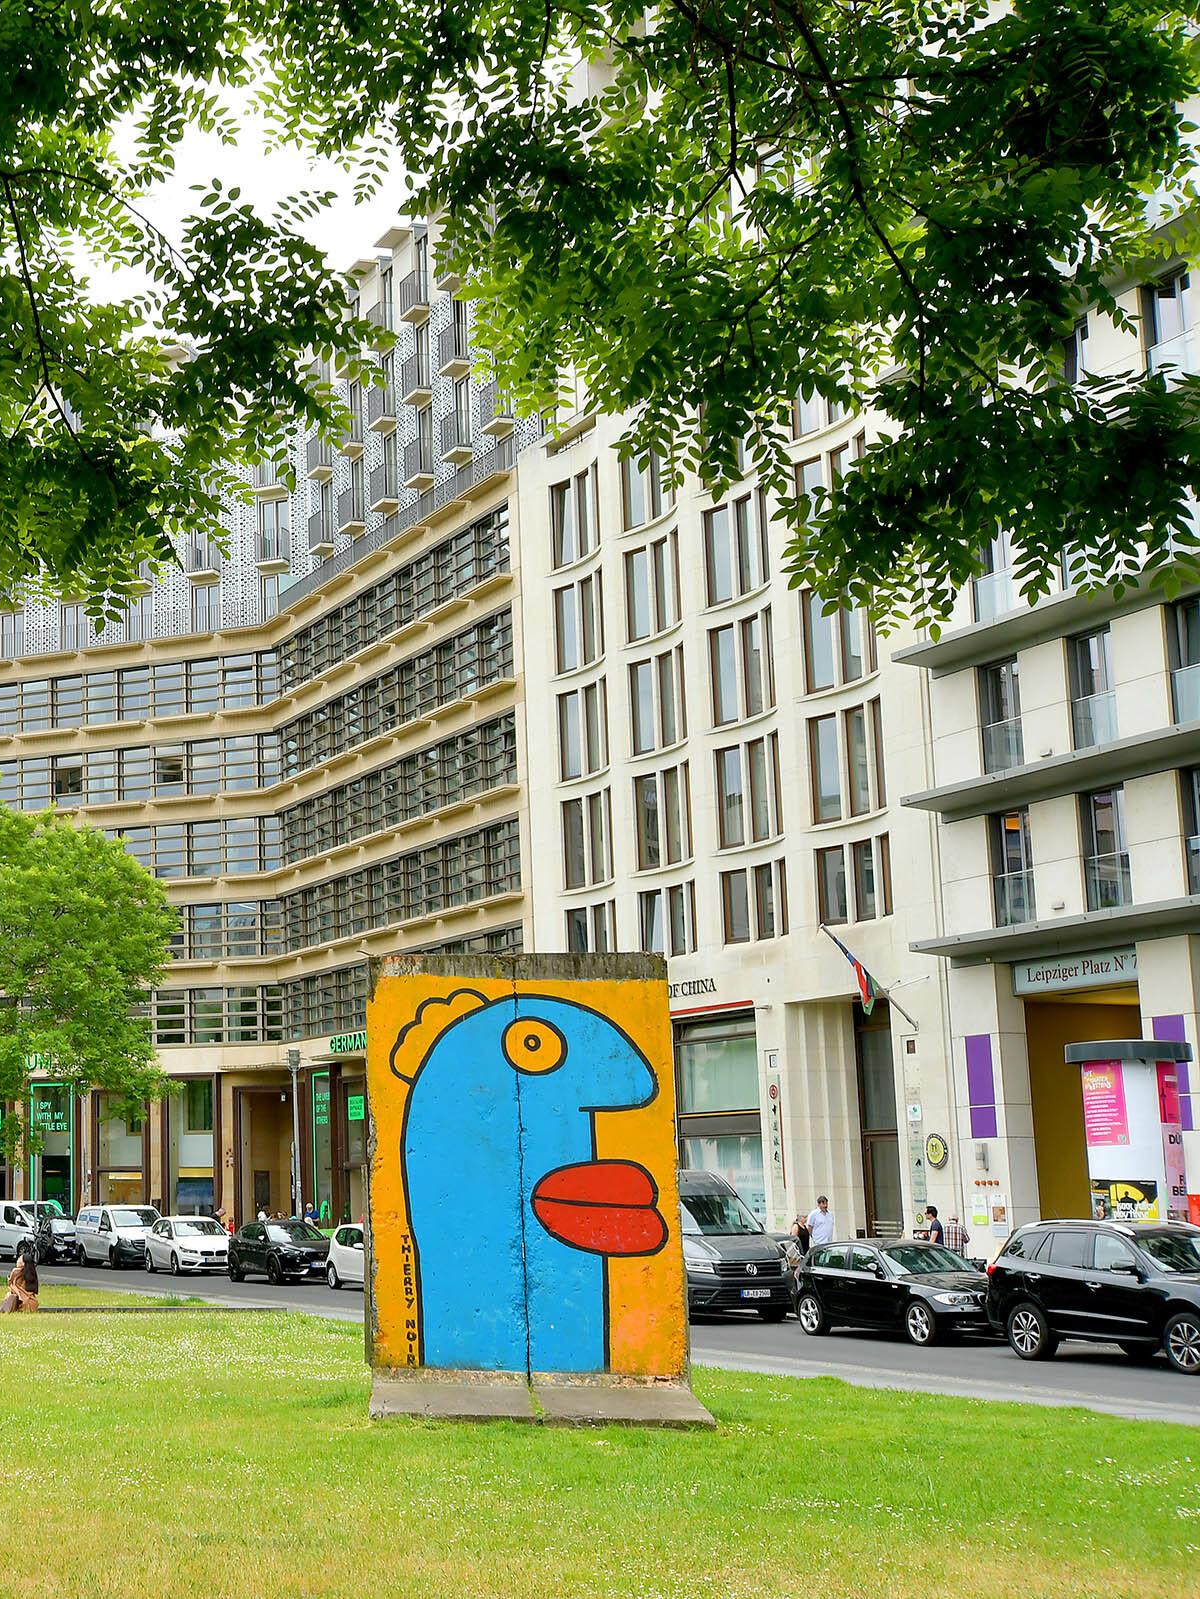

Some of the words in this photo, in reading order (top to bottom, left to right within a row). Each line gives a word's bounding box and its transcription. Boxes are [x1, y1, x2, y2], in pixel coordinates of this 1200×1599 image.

[1027, 964, 1079, 983] Leipziger
[1081, 960, 1111, 976] Platz
[681, 978, 717, 996] CHINA
[329, 1032, 367, 1053] GERMAN
[40, 1101, 52, 1110] SPY
[54, 1112, 64, 1120] MY
[56, 1122, 68, 1131] EYE
[401, 1235, 414, 1309] THIERRY
[405, 1320, 417, 1367] NOIR
